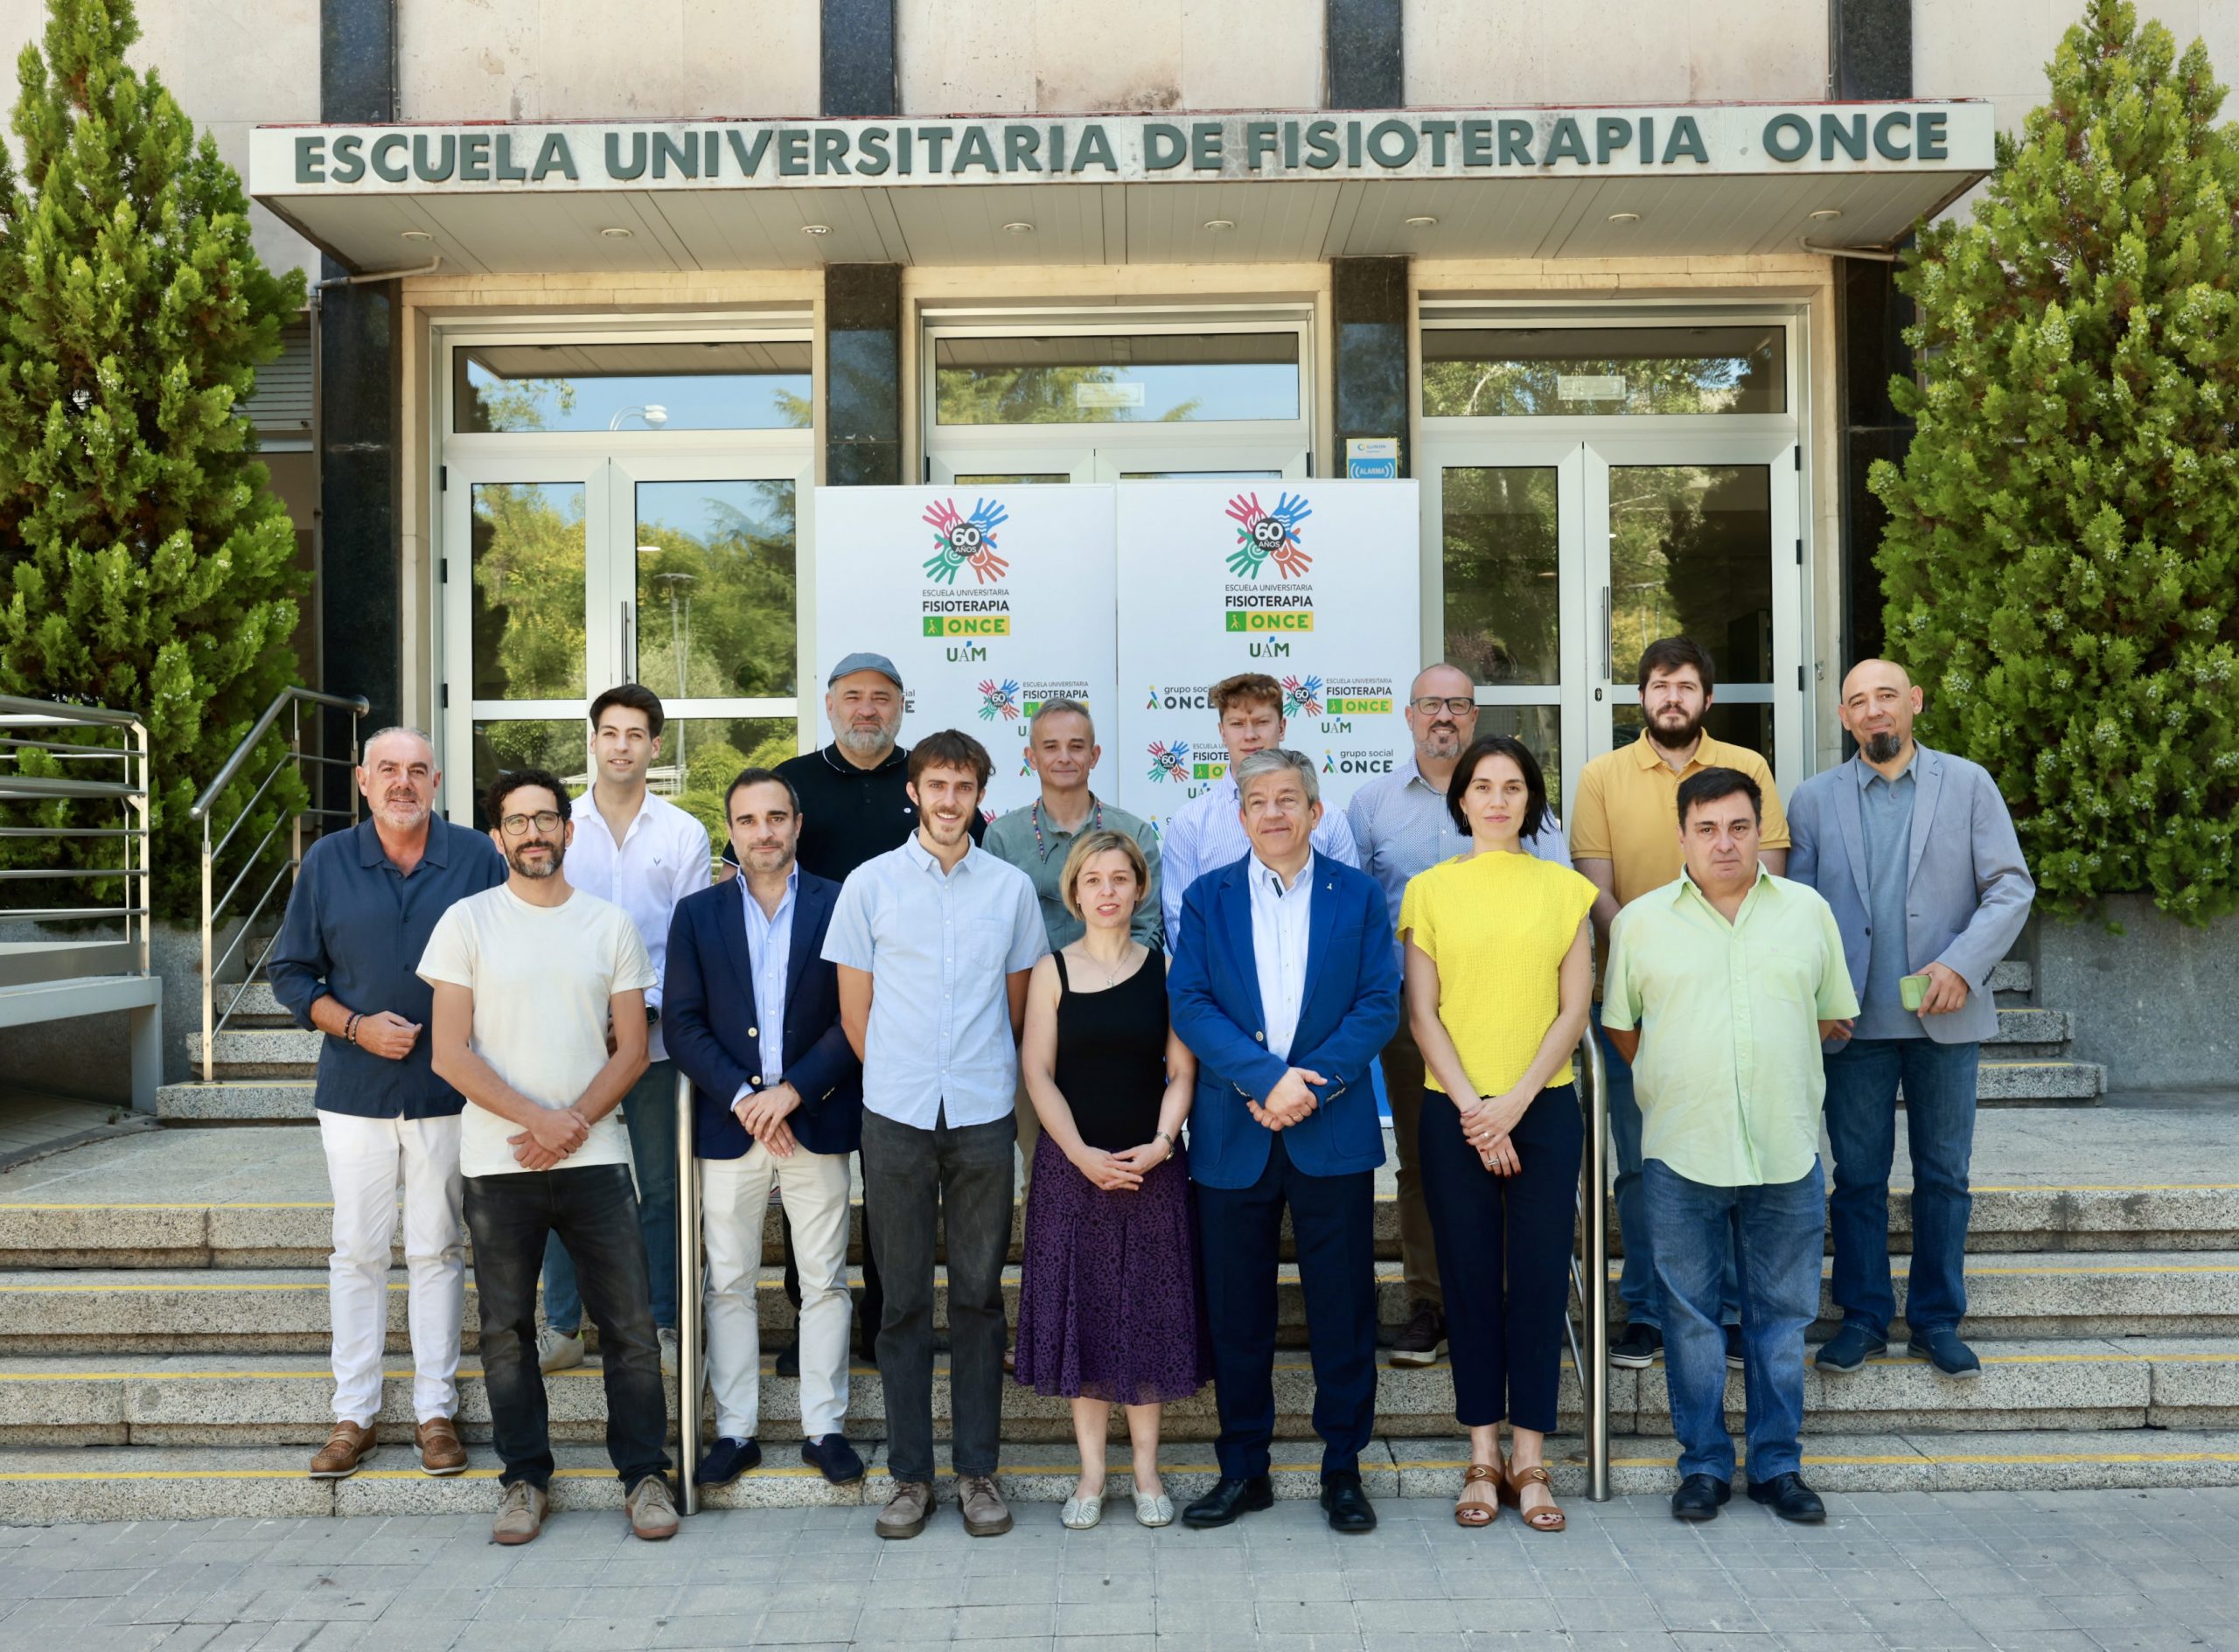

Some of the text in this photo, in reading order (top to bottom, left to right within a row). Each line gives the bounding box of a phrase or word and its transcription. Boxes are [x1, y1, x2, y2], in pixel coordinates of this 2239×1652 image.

[295, 111, 1949, 184] ESCUELA UNIVERSITARIA DE FISIOTERAPIA ONCE
[1254, 522, 1284, 540] 60
[951, 527, 980, 547] 60
[1258, 540, 1280, 548] AÑOS
[955, 545, 977, 554] AÑOS
[922, 600, 1009, 612] FISIOTERAPIA
[1225, 596, 1314, 607] FISIOTERAPIA
[947, 618, 1006, 633] ONCE
[1251, 614, 1308, 629] ONCE
[1022, 690, 1089, 699] FISIOTERAPIA
[1164, 686, 1191, 695] grupo
[1294, 689, 1309, 699] 60
[1326, 687, 1392, 695] FISIOTERAPIA
[991, 694, 1006, 703] 60
[1345, 701, 1389, 712] ONCE
[1193, 752, 1230, 761] FISIOTE
[1368, 749, 1394, 757] social
[1161, 755, 1176, 764] 60
[1340, 760, 1393, 773] ONCE
